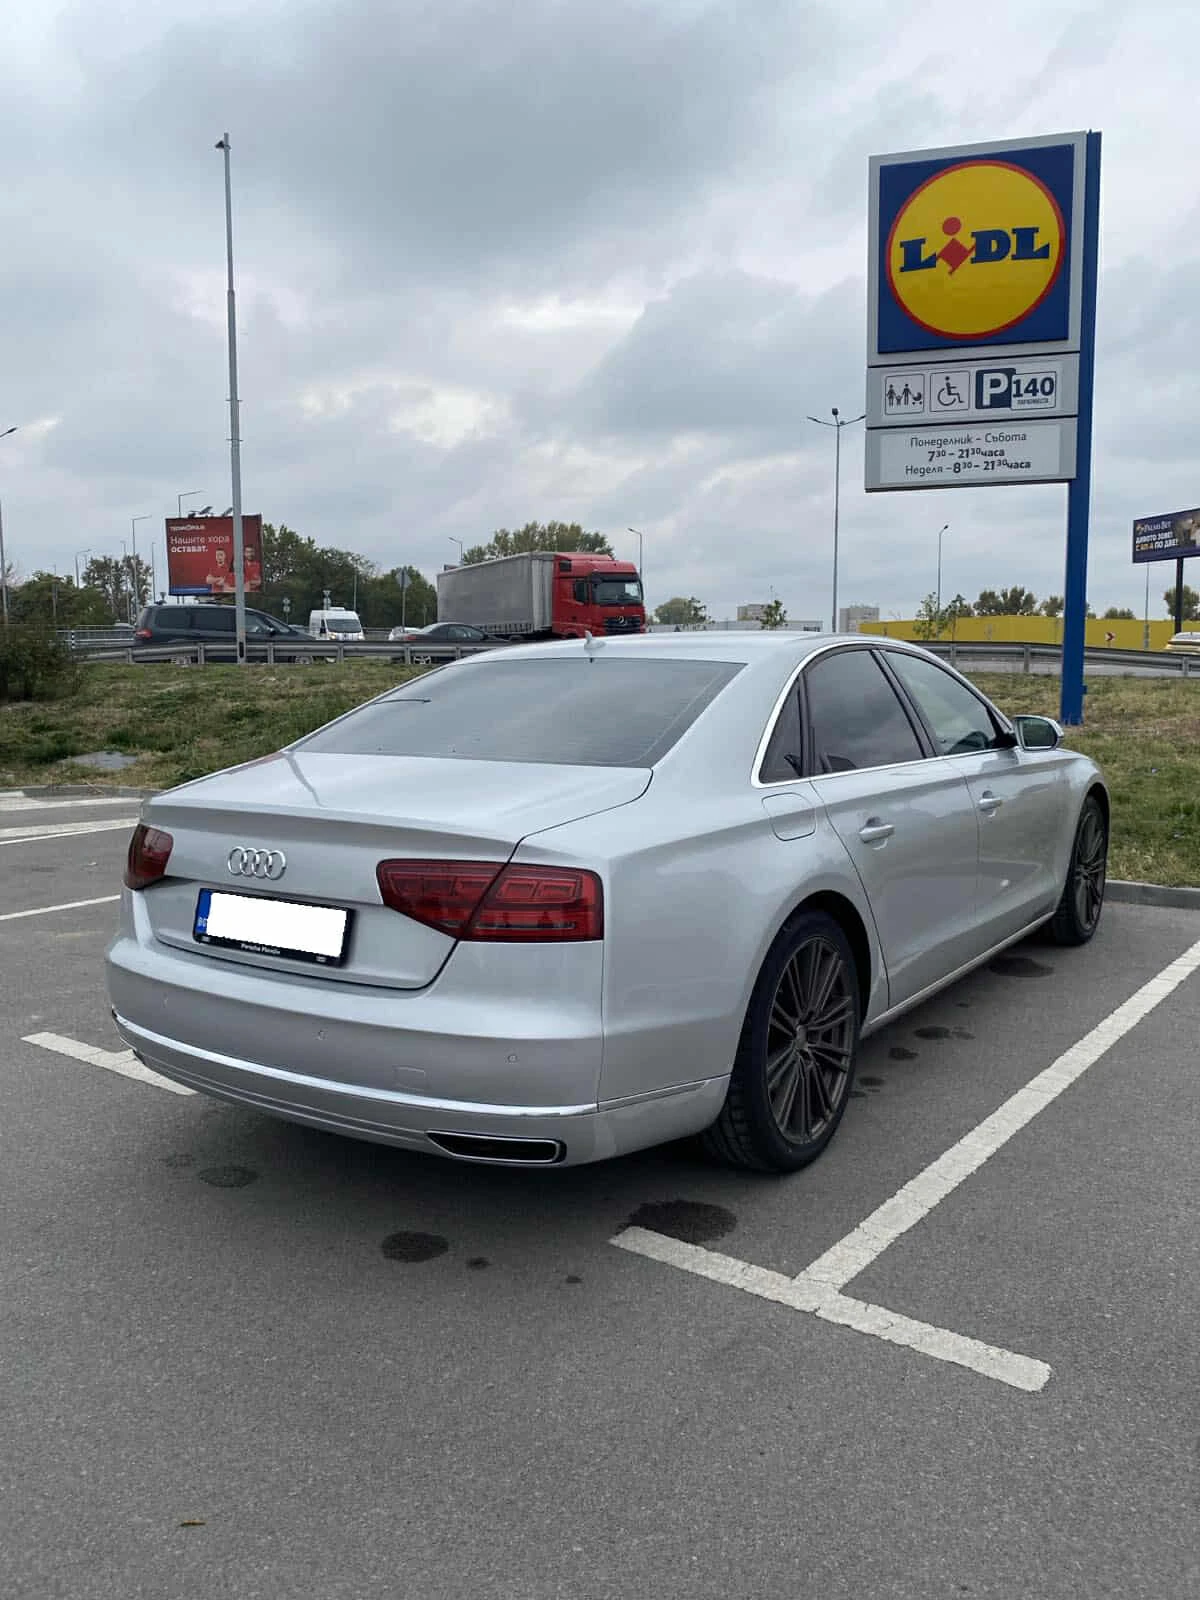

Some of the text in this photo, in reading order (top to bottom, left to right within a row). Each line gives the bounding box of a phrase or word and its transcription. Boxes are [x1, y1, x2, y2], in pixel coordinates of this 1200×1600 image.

[982, 372, 1054, 407] P 140
[910, 434, 973, 448] Понеделник
[984, 431, 1027, 443] Събота
[905, 465, 943, 476] Неделя
[170, 536, 230, 544] Нашите хора
